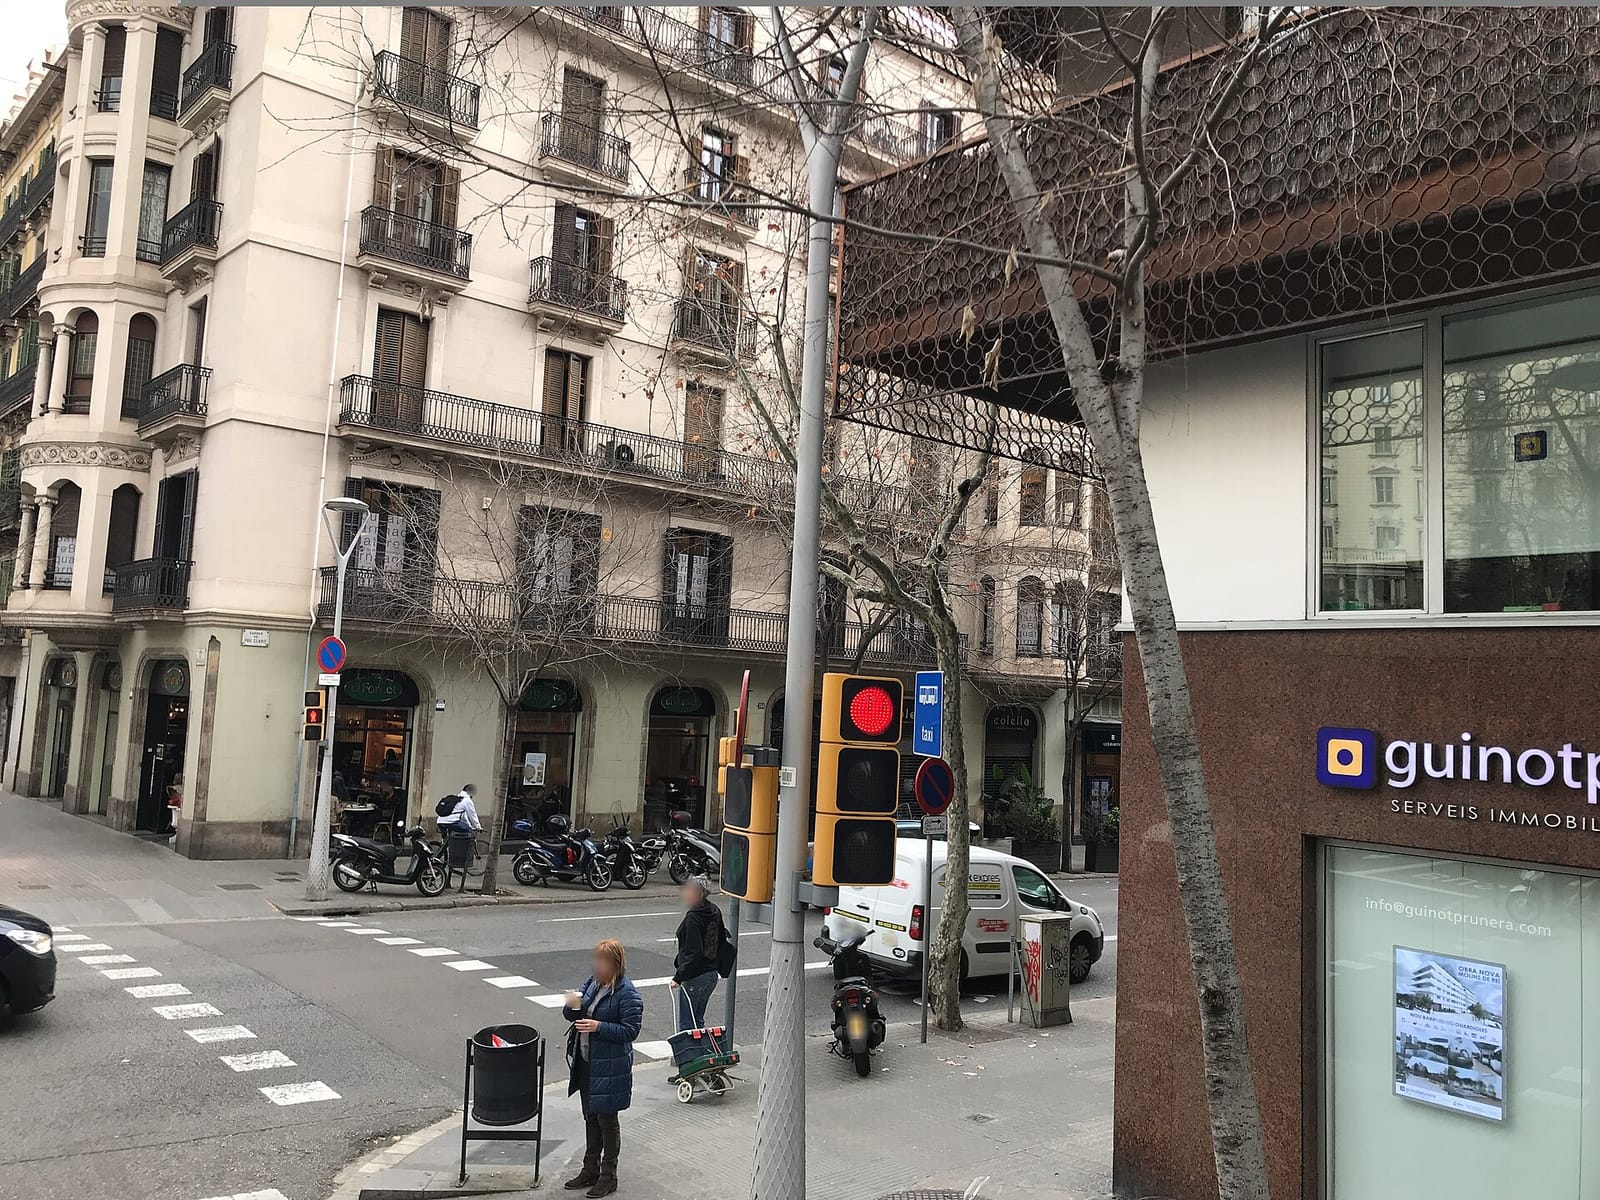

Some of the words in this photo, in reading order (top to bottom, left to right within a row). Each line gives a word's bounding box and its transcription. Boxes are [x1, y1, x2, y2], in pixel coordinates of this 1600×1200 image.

[993, 715, 1030, 727] colella
[921, 725, 934, 742] taxi
[1390, 799, 1479, 820] SERVEIS
[1365, 897, 1552, 937] info@guinotprunera.com
[1479, 969, 1500, 978] NOVA
